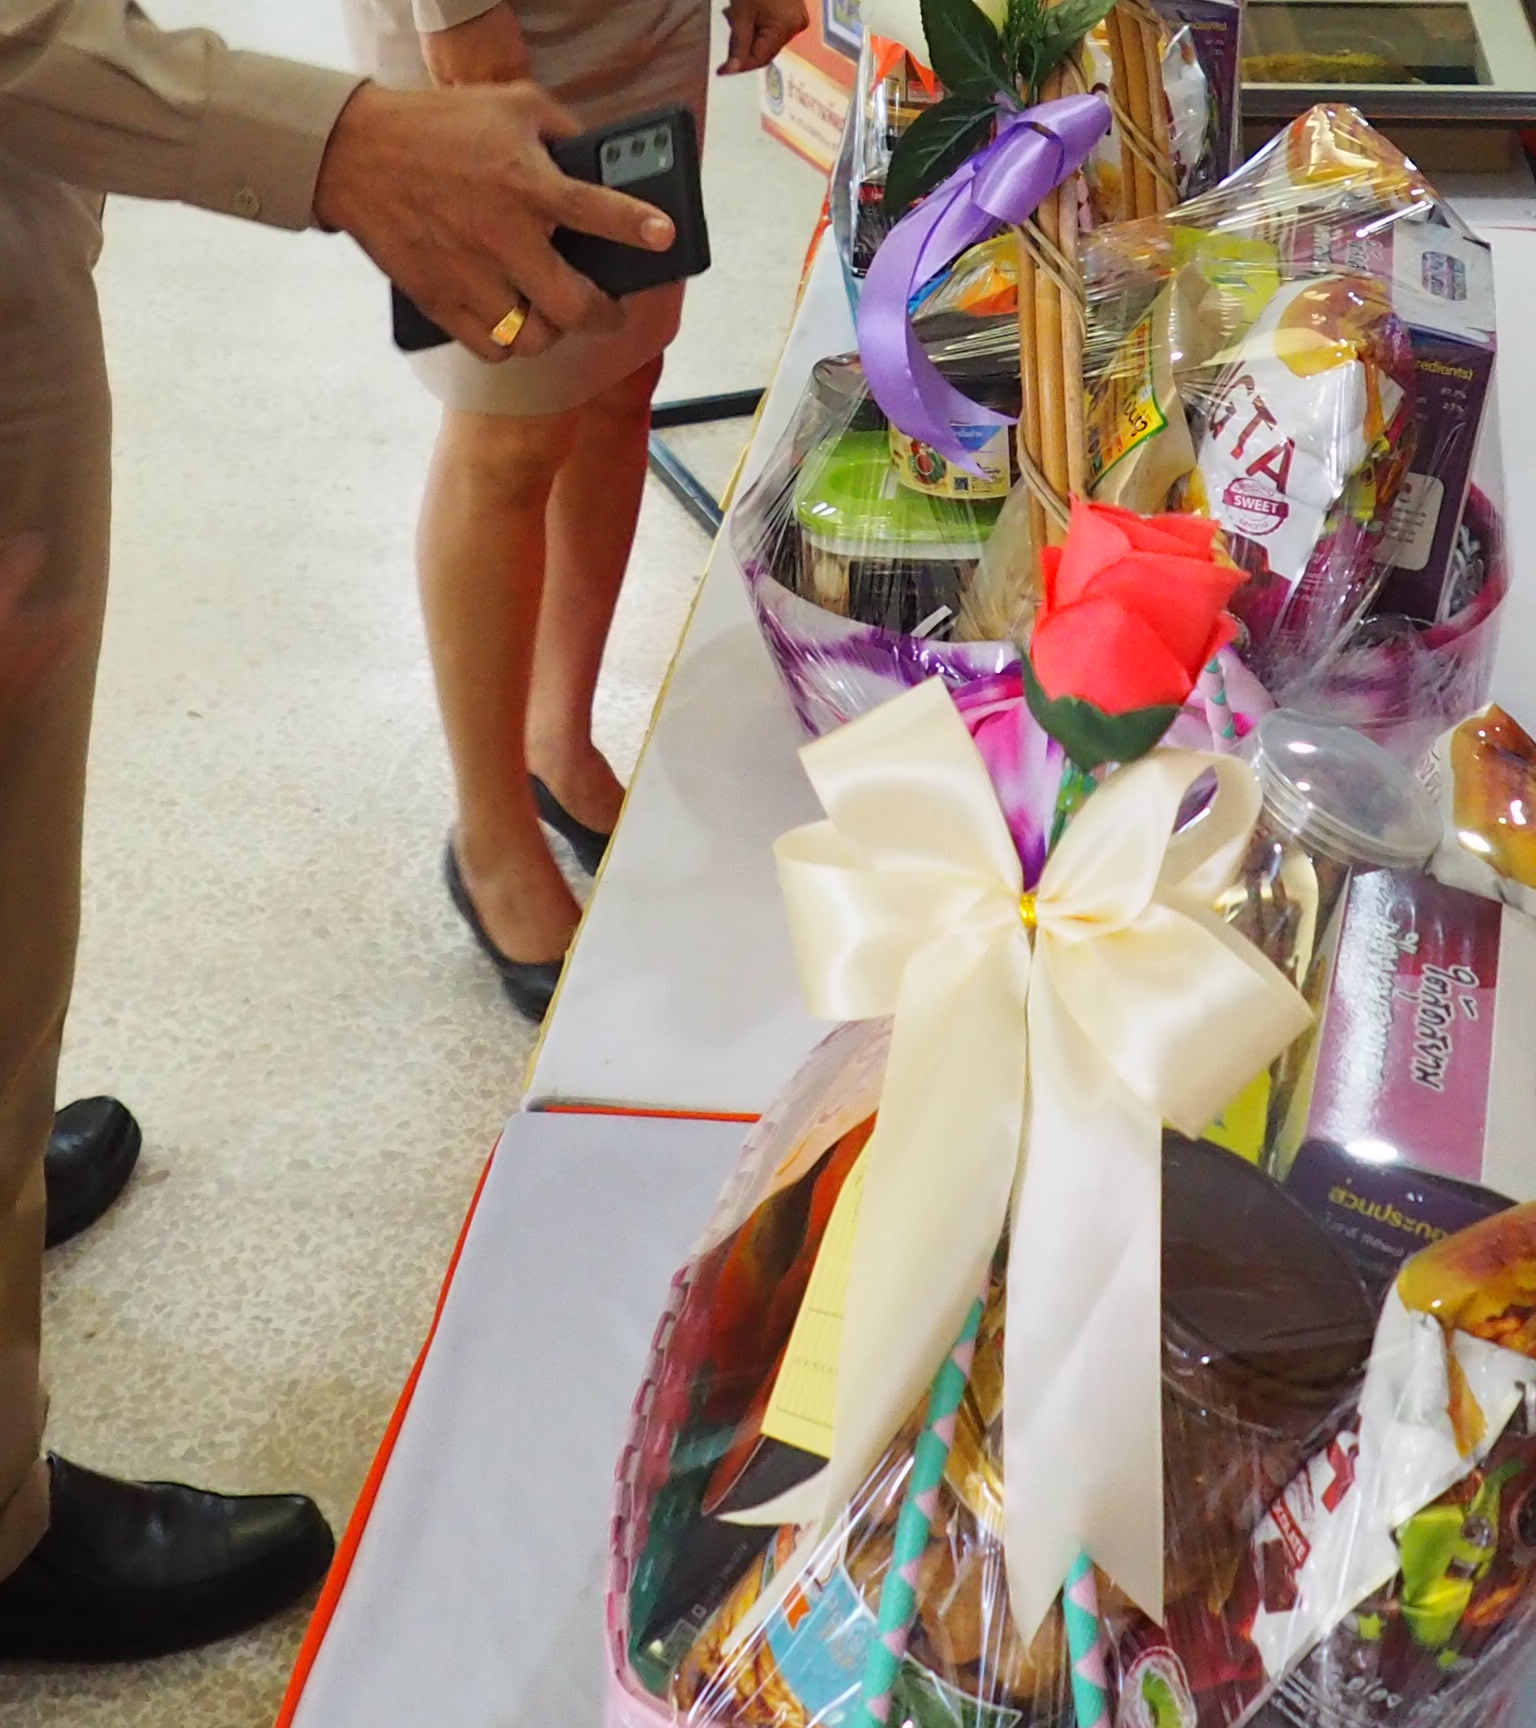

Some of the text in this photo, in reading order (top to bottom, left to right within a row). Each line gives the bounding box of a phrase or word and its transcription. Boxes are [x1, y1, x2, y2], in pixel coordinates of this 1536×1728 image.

[1416, 359, 1473, 381] redients)
[1233, 493, 1279, 515] SWEET
[1328, 1176, 1447, 1242] ส่วนประกอ
